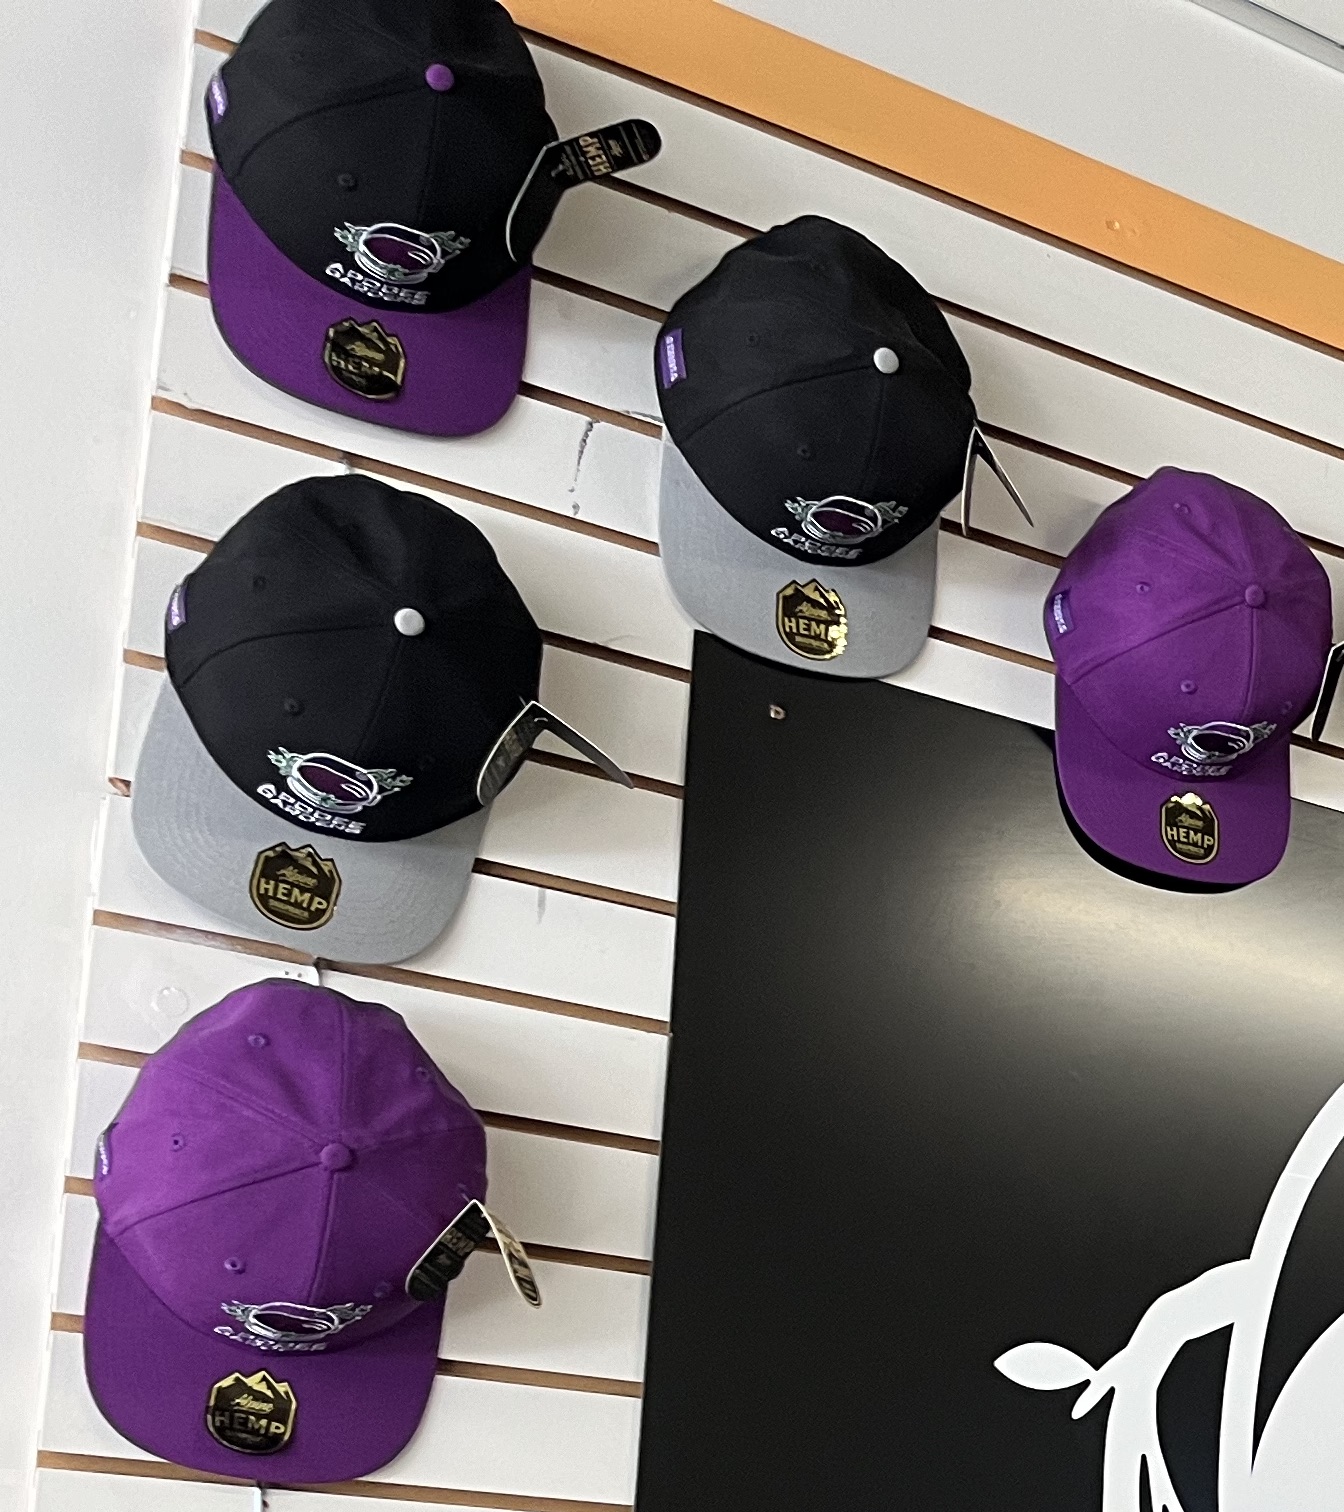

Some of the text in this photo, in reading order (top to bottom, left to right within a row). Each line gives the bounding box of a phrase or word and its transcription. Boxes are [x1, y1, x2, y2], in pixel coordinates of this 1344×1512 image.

[784, 617, 838, 642] HEM
[1166, 826, 1214, 849] HEMP
[258, 877, 328, 912] HEMP
[214, 1410, 286, 1435] HEMP
